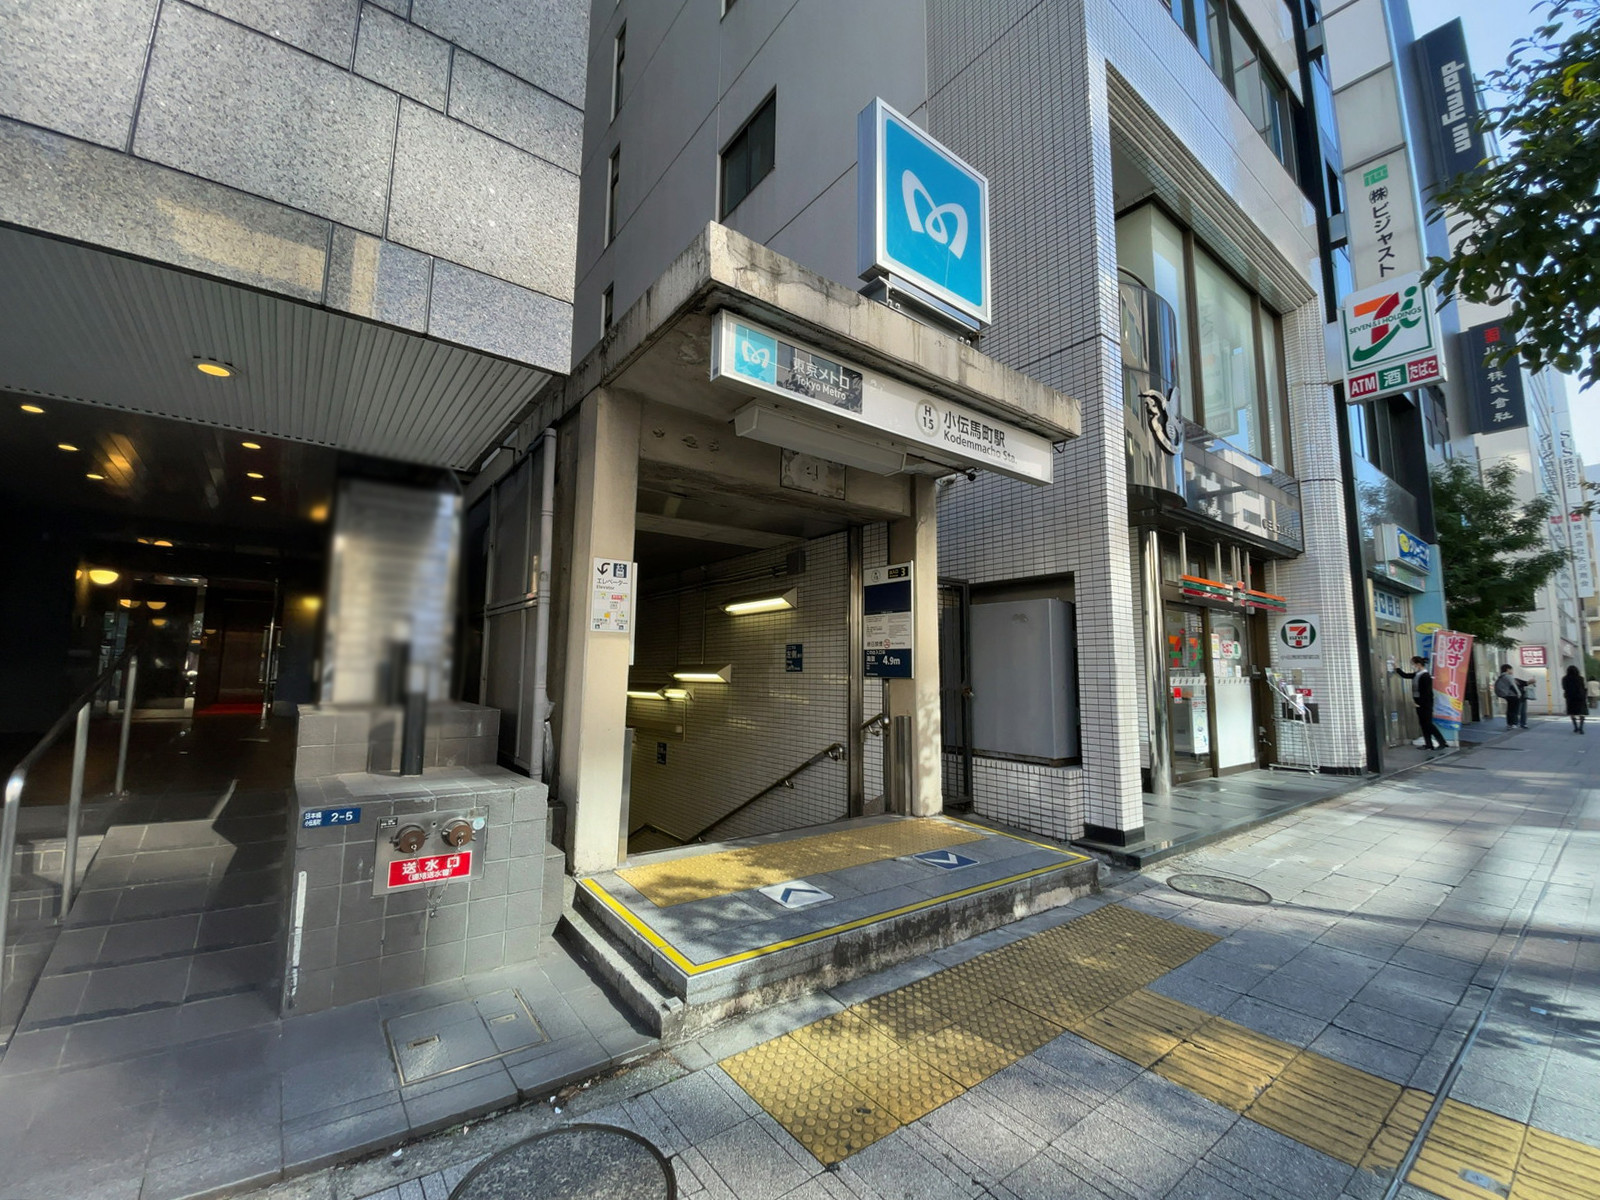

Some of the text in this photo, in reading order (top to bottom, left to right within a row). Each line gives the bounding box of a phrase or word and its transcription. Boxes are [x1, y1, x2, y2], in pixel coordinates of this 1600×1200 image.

[1441, 61, 1472, 153] dormy inn
[1382, 307, 1422, 324] HOLDINGS
[793, 357, 850, 389] 東京メトロ
[1351, 360, 1438, 395] ATM 酒 たばこ
[796, 374, 847, 400] Tokyo Metro
[924, 405, 932, 417] H
[922, 416, 934, 430] 15
[944, 411, 1006, 448] 小伝馬町駅
[943, 430, 1018, 465] Kodemmacho Sta.
[900, 567, 906, 577] 3
[596, 578, 628, 586] エレベーター
[882, 655, 901, 666] 4.9m
[331, 811, 353, 823] 2-5
[401, 856, 460, 876] 送水口
